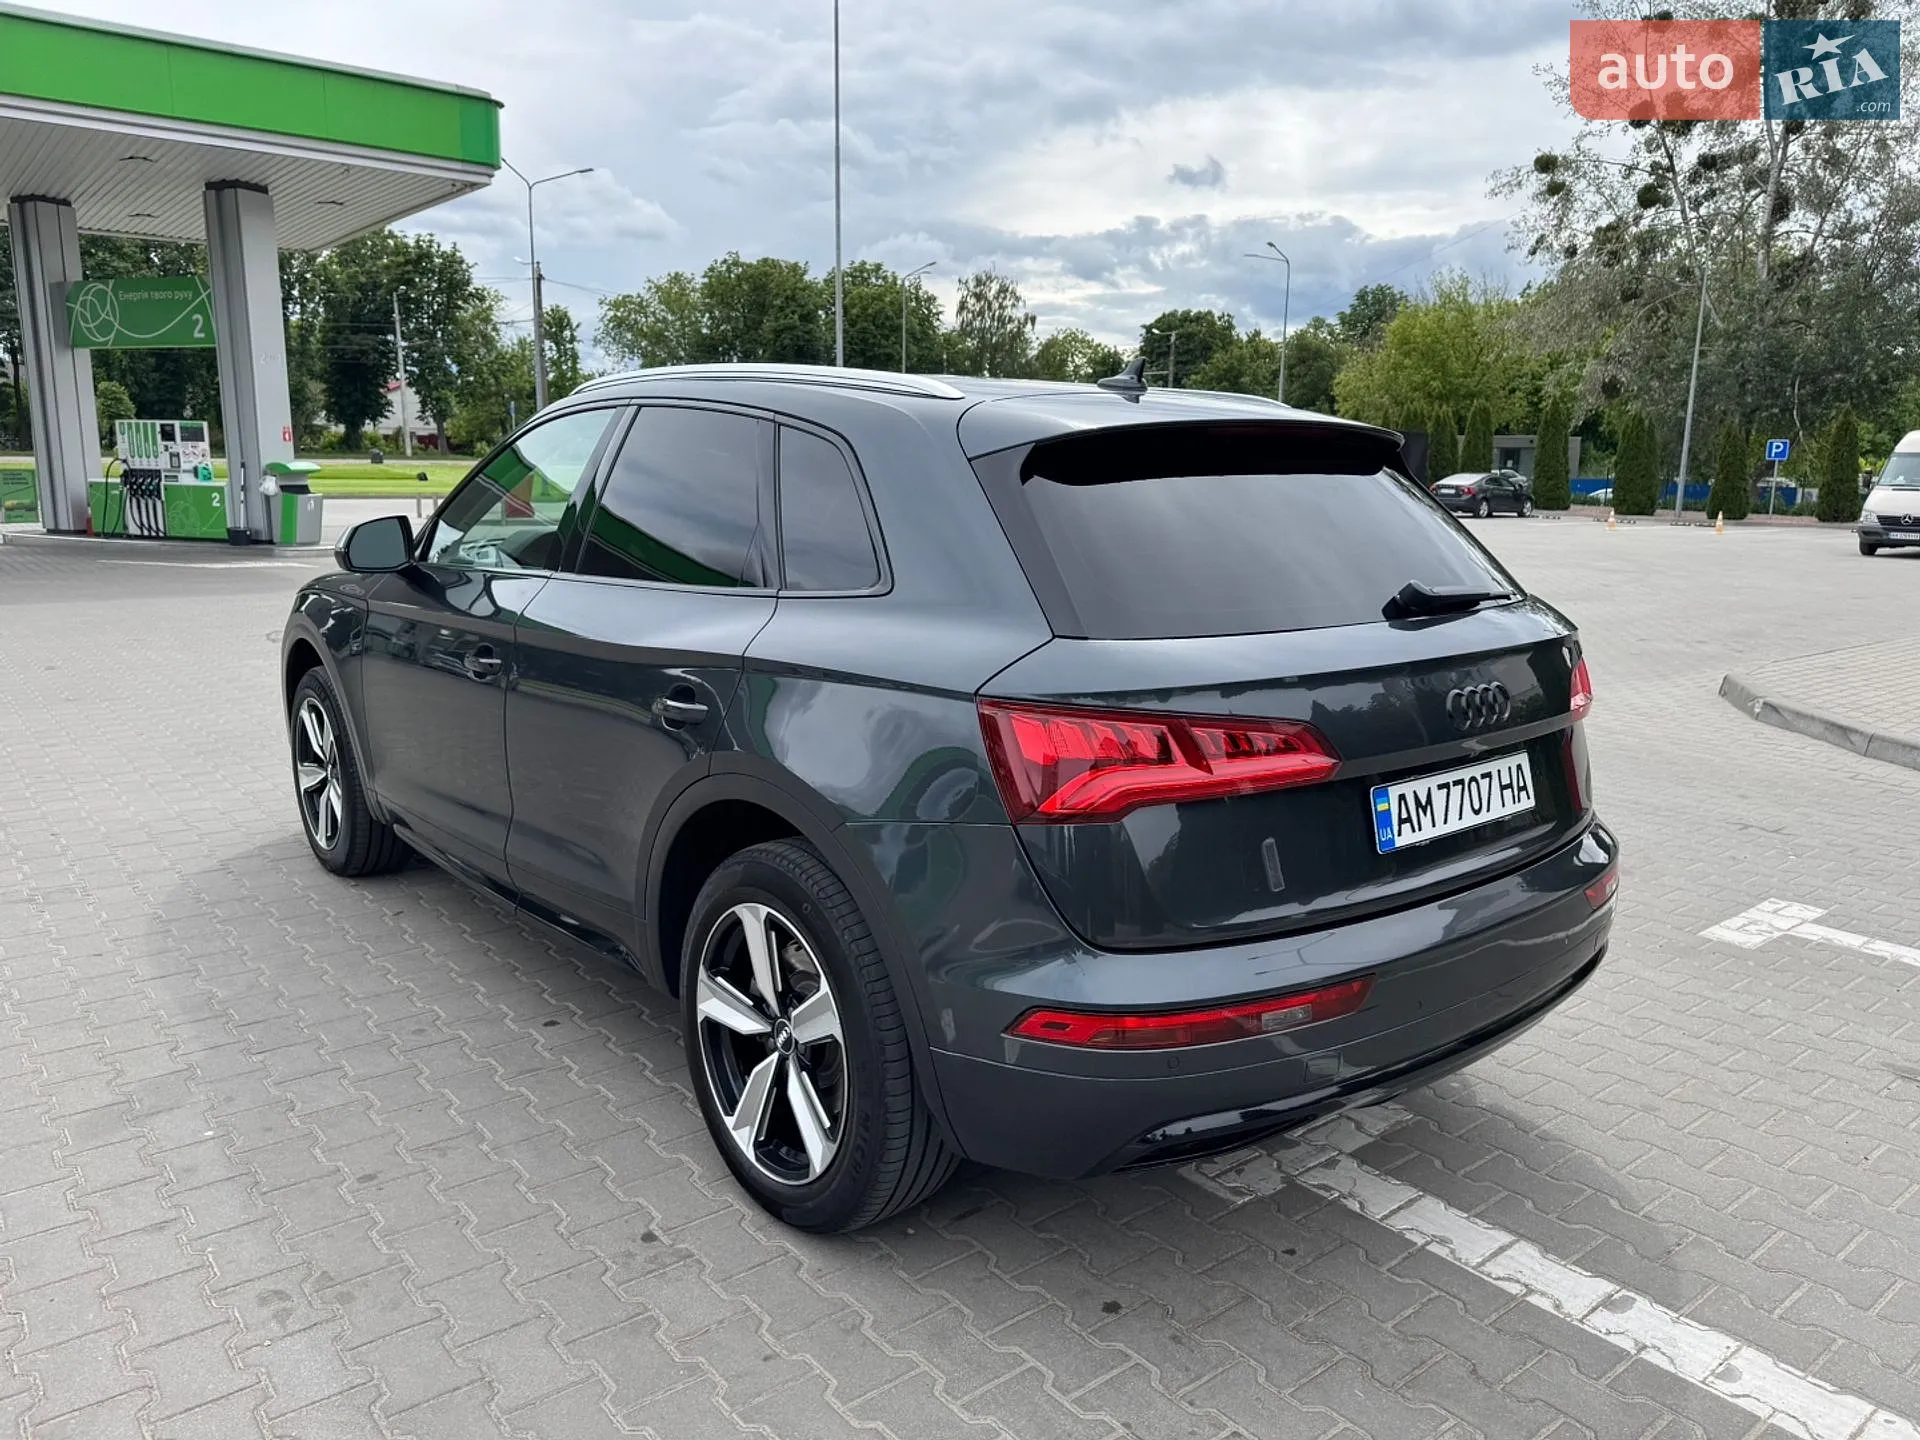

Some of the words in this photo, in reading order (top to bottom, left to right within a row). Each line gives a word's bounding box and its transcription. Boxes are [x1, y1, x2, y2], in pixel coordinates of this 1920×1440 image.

[191, 313, 205, 339] 2
[1771, 442, 1784, 458] P
[211, 492, 221, 507] 2
[1397, 786, 1436, 837] AM
[1436, 771, 1493, 825] 7707
[1497, 763, 1531, 809] HA
[1379, 828, 1393, 841] UA
